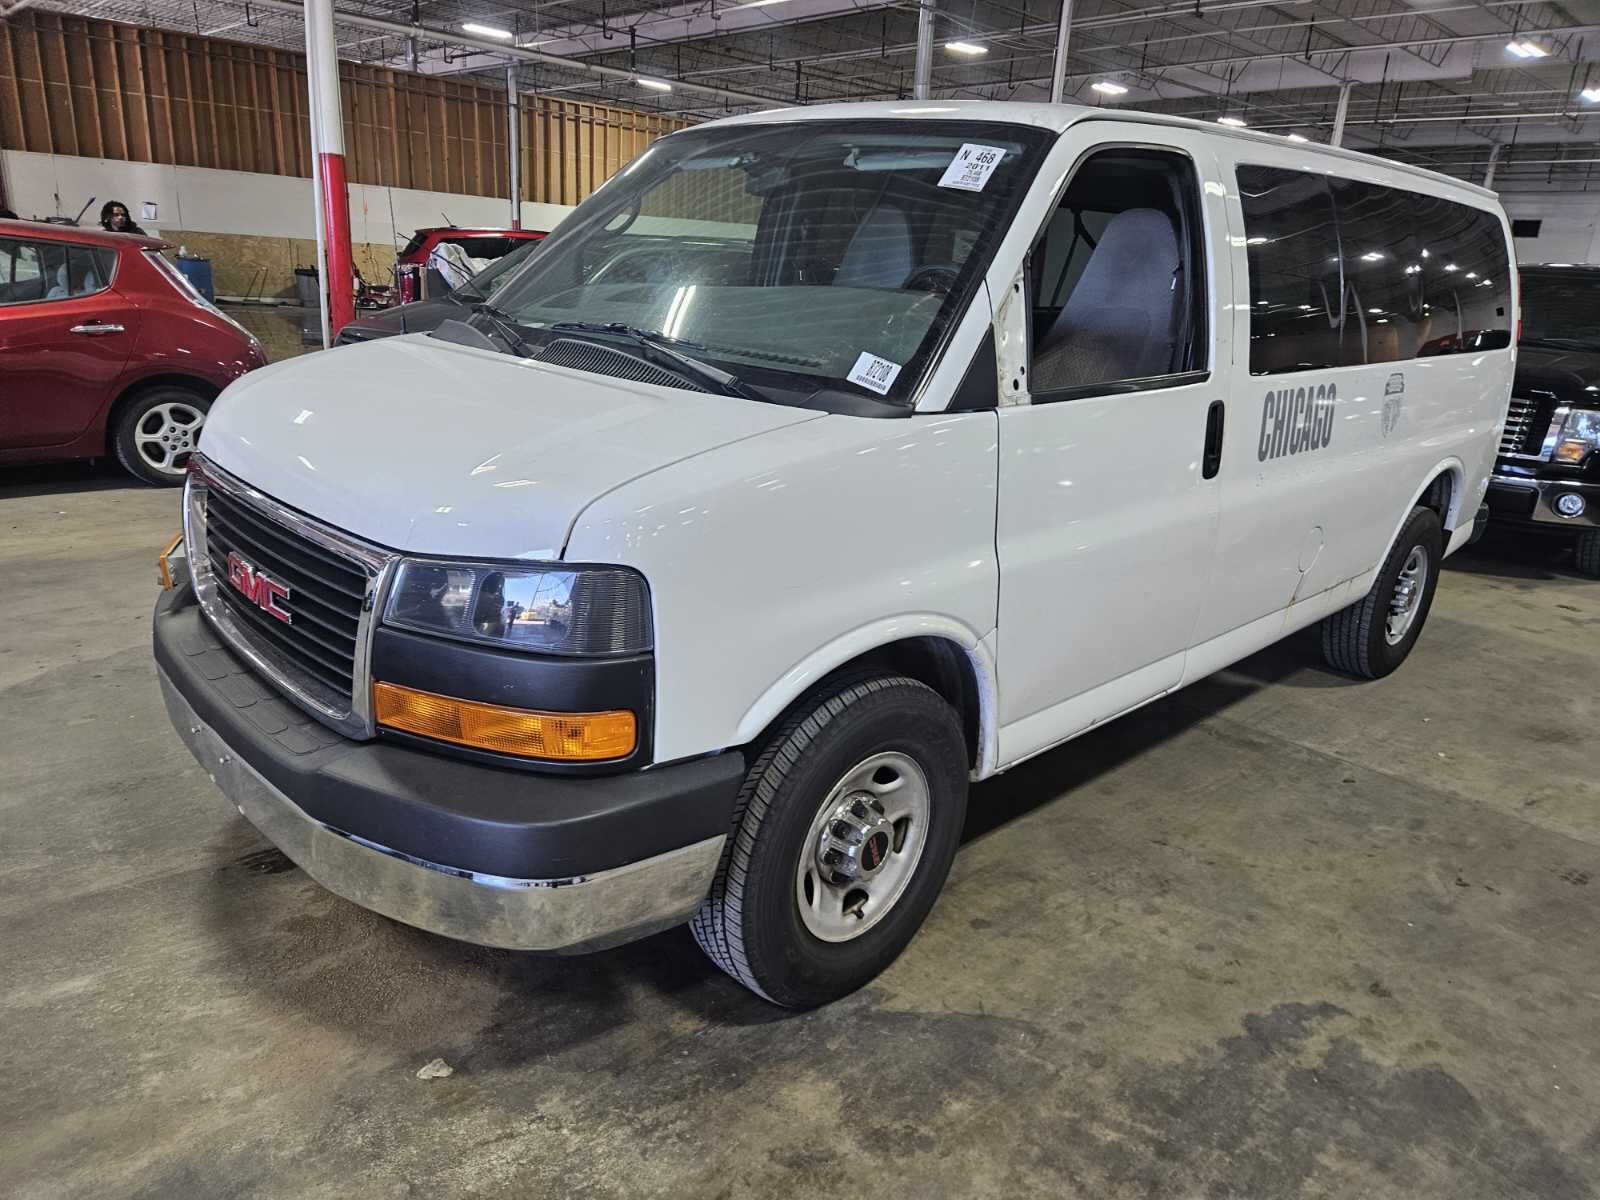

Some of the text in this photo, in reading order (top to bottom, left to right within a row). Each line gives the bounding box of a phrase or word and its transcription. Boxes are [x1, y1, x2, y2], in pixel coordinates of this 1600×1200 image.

[960, 150, 996, 164] N 468
[965, 162, 991, 171] 2011
[1258, 383, 1337, 462] CHICAGO
[226, 551, 291, 624] GMC
